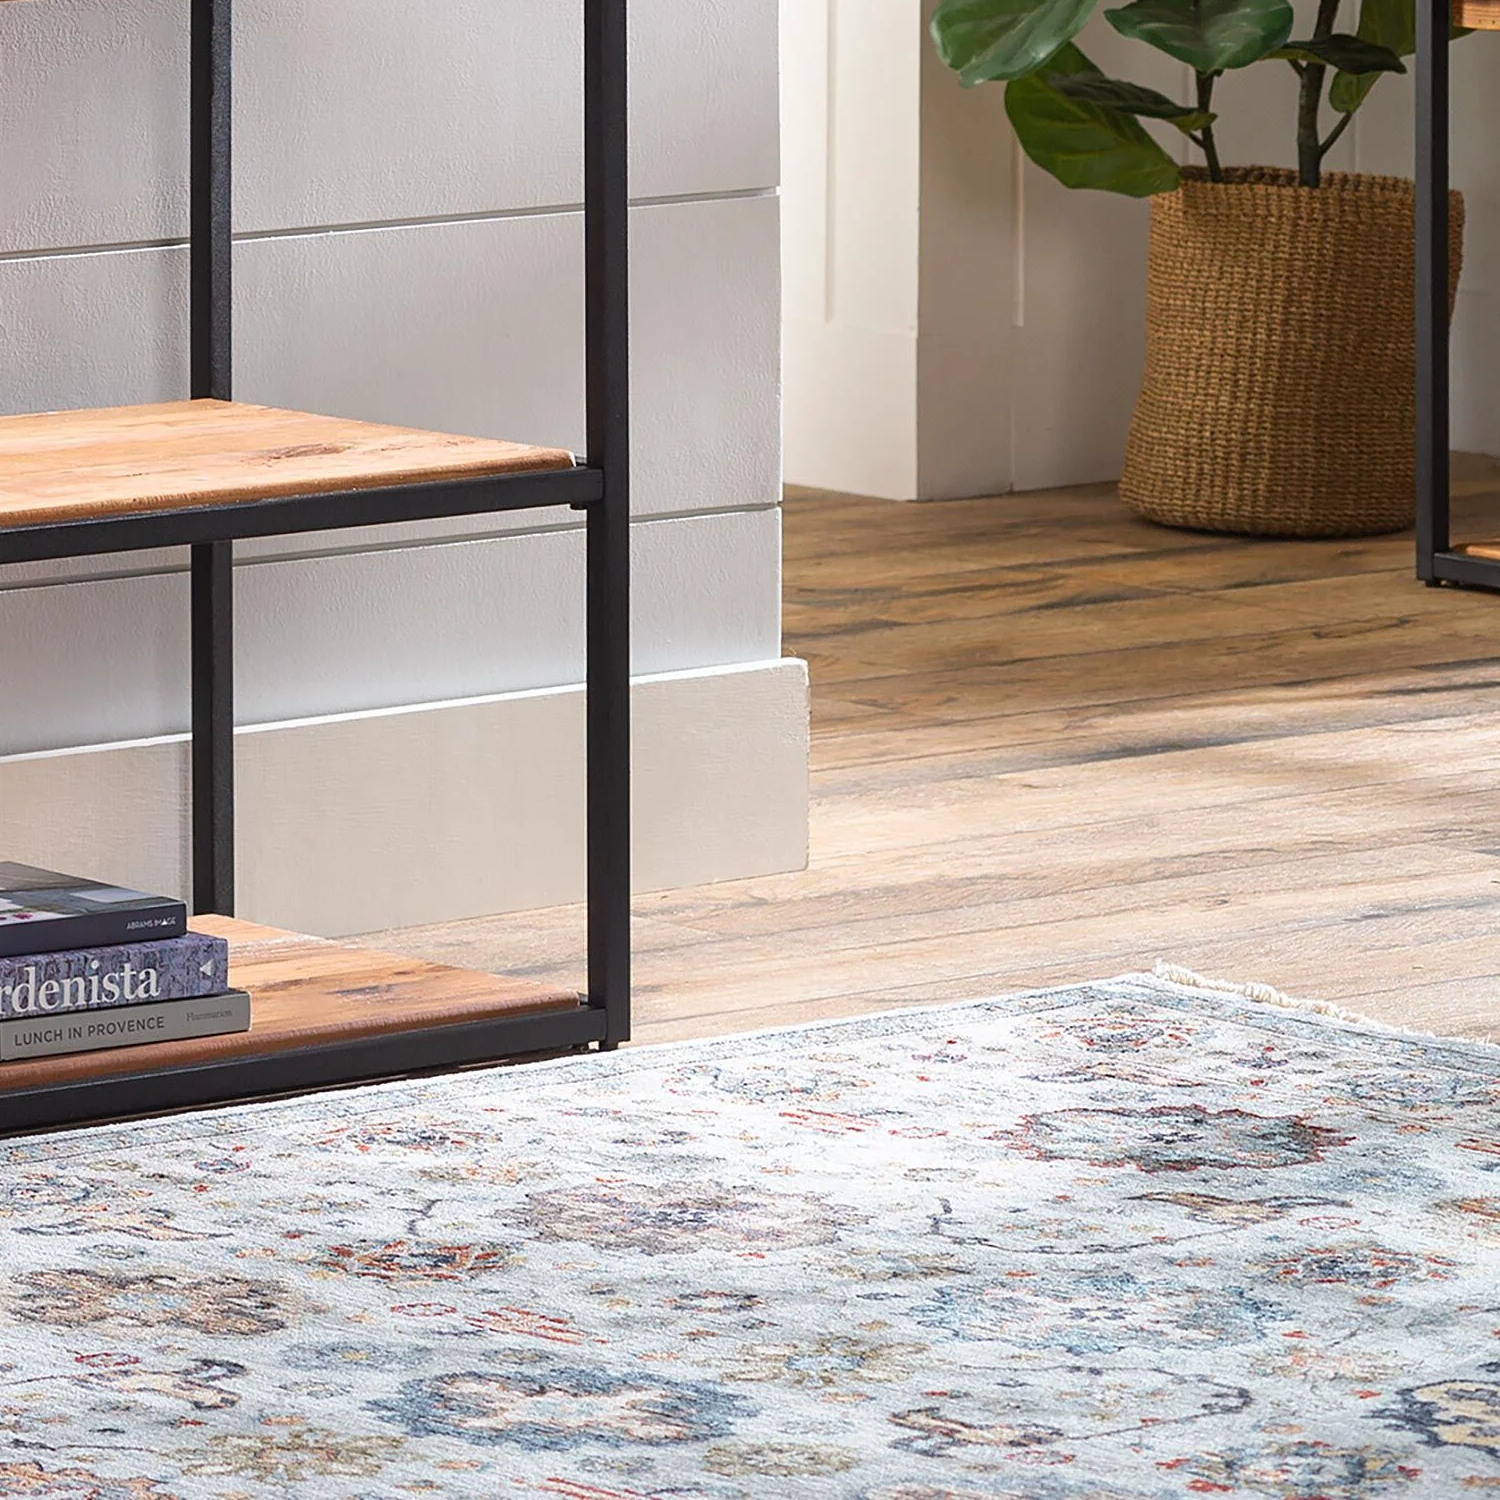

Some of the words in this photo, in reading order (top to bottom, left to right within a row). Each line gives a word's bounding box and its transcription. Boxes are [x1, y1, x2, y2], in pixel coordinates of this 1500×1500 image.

[126, 919, 153, 931] ABRAMS
[154, 916, 177, 928] IMAGE
[14, 1029, 63, 1047] LUNCH
[67, 1025, 84, 1041] IN
[87, 1016, 165, 1036] PROVENCE
